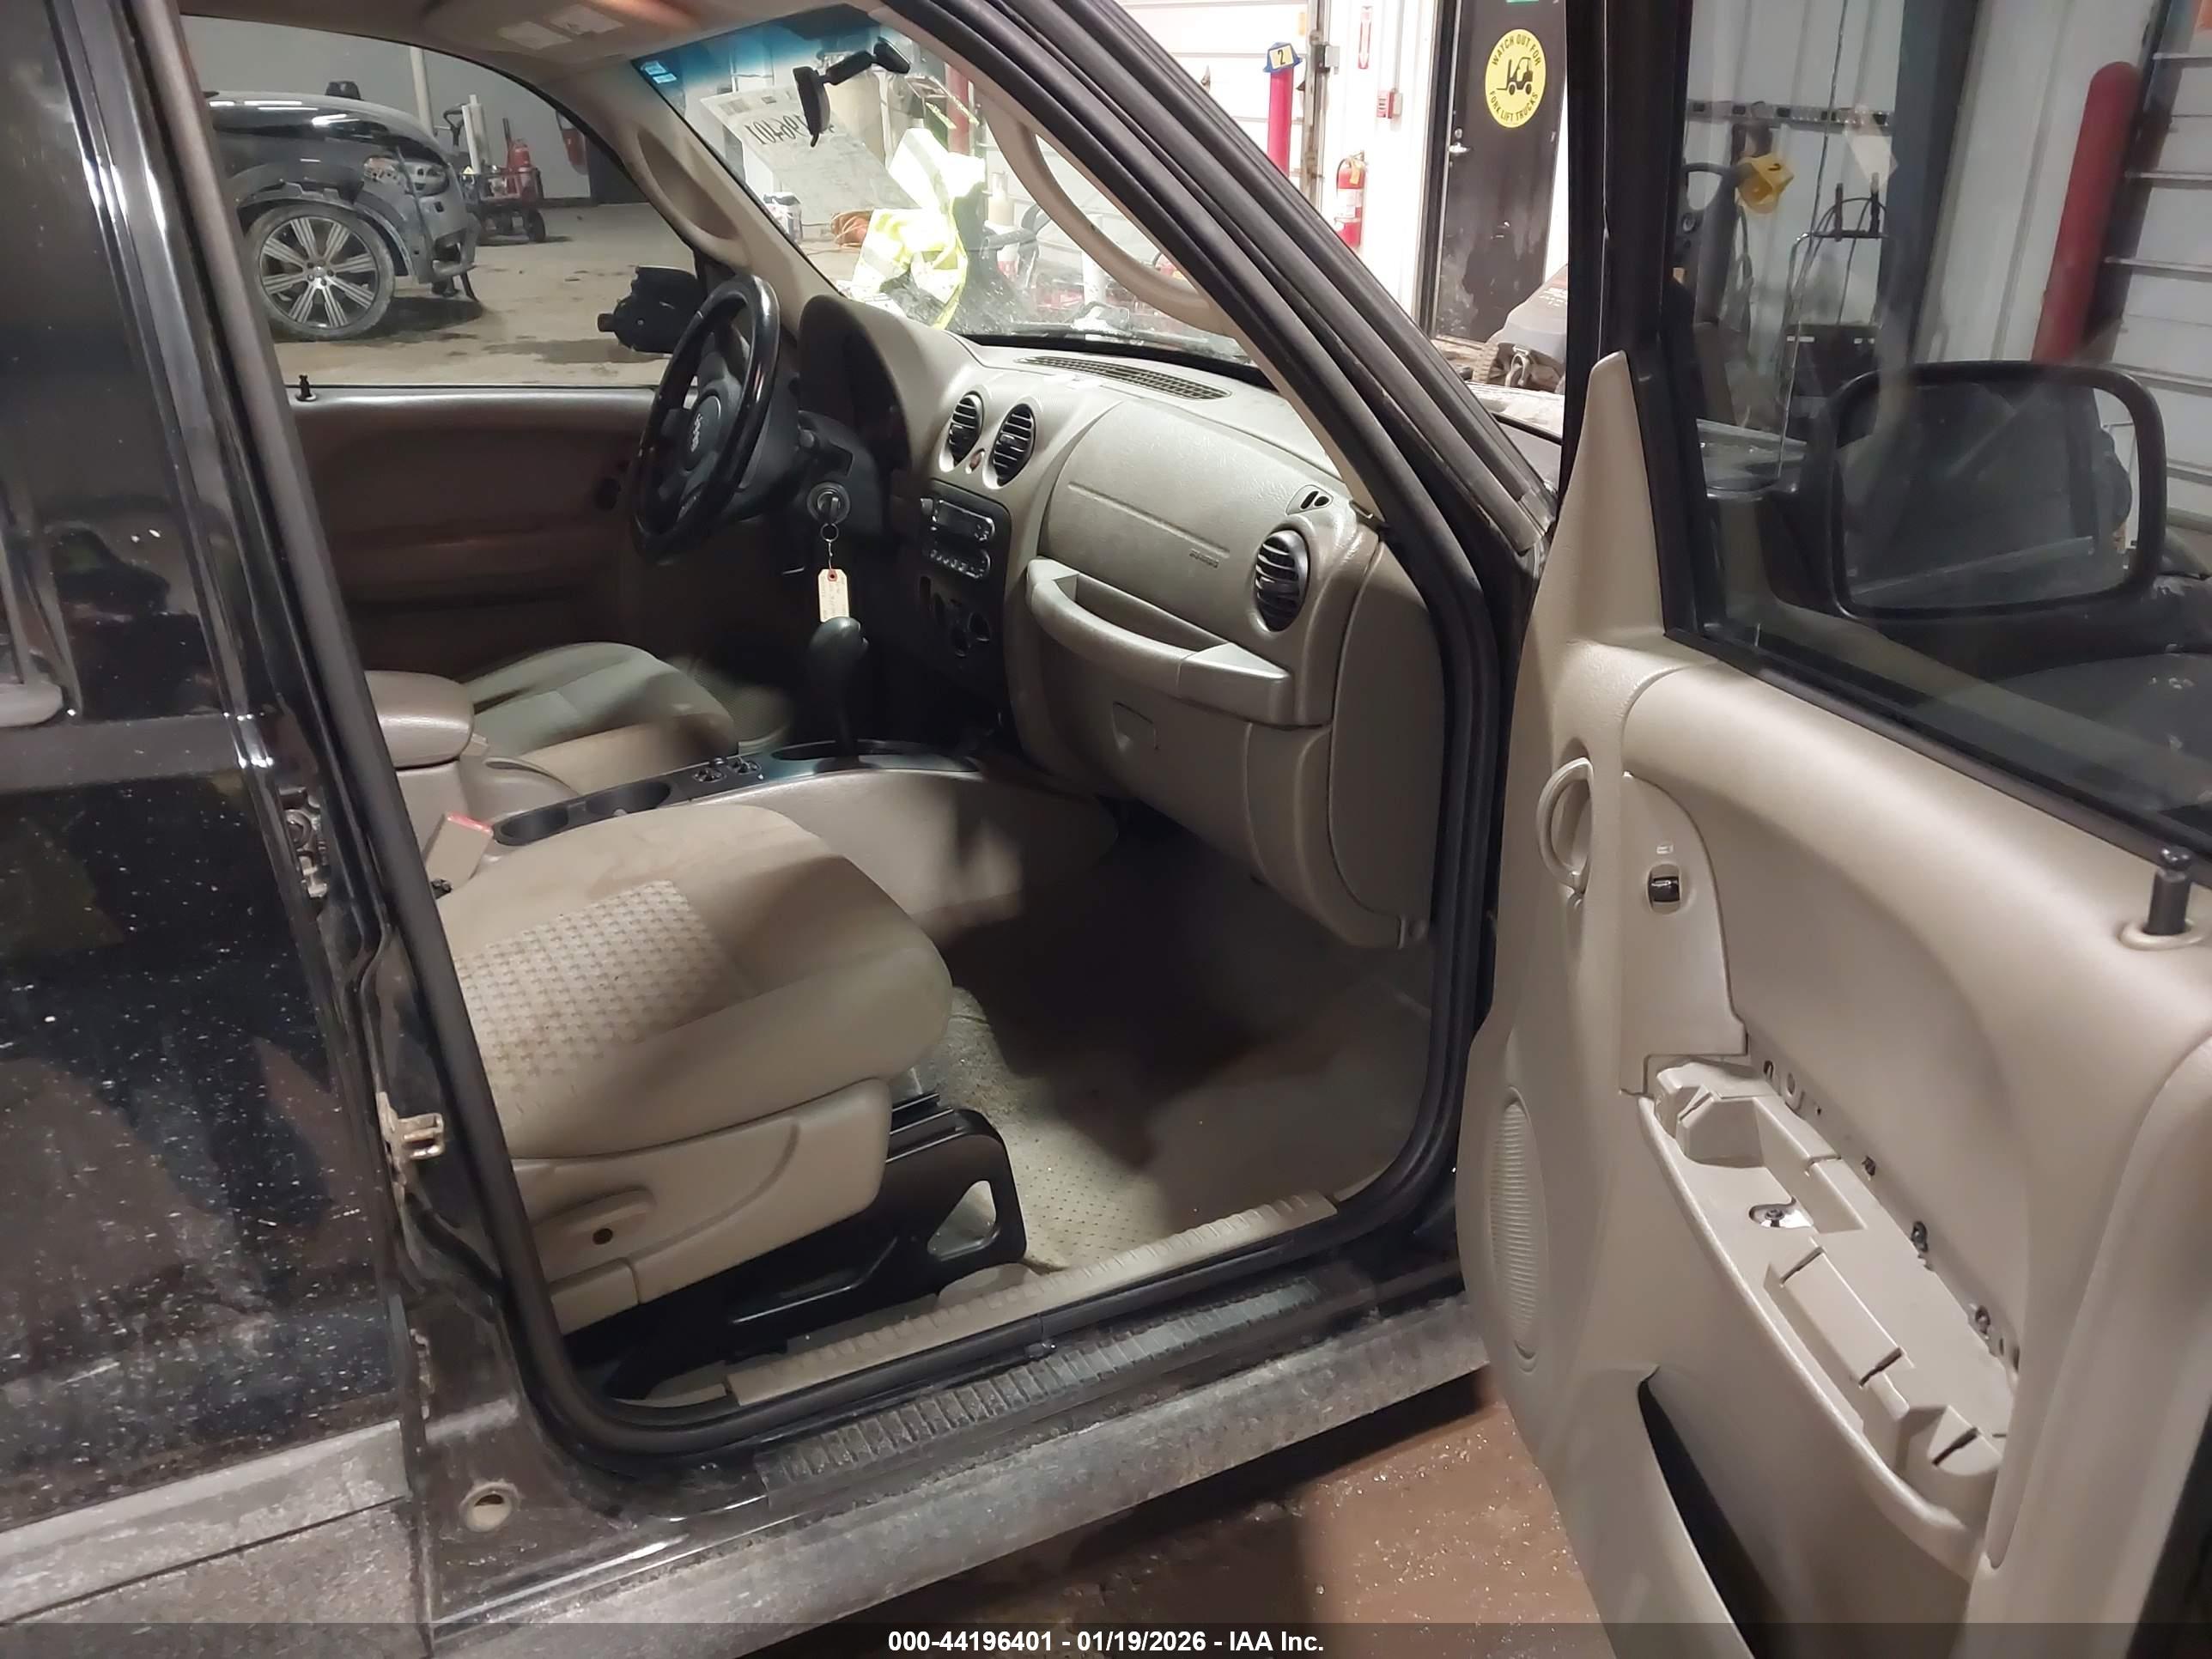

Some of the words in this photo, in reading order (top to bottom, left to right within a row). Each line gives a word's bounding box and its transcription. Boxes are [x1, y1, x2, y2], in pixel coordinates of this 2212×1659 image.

[1278, 49, 1286, 65] 2
[1492, 35, 1514, 65] WATCH
[1516, 33, 1531, 48] OUT
[1529, 44, 1541, 66] FOR
[1490, 90, 1502, 113] FORK
[1500, 111, 1514, 122] LIFT
[1516, 92, 1539, 121] TRUCKS
